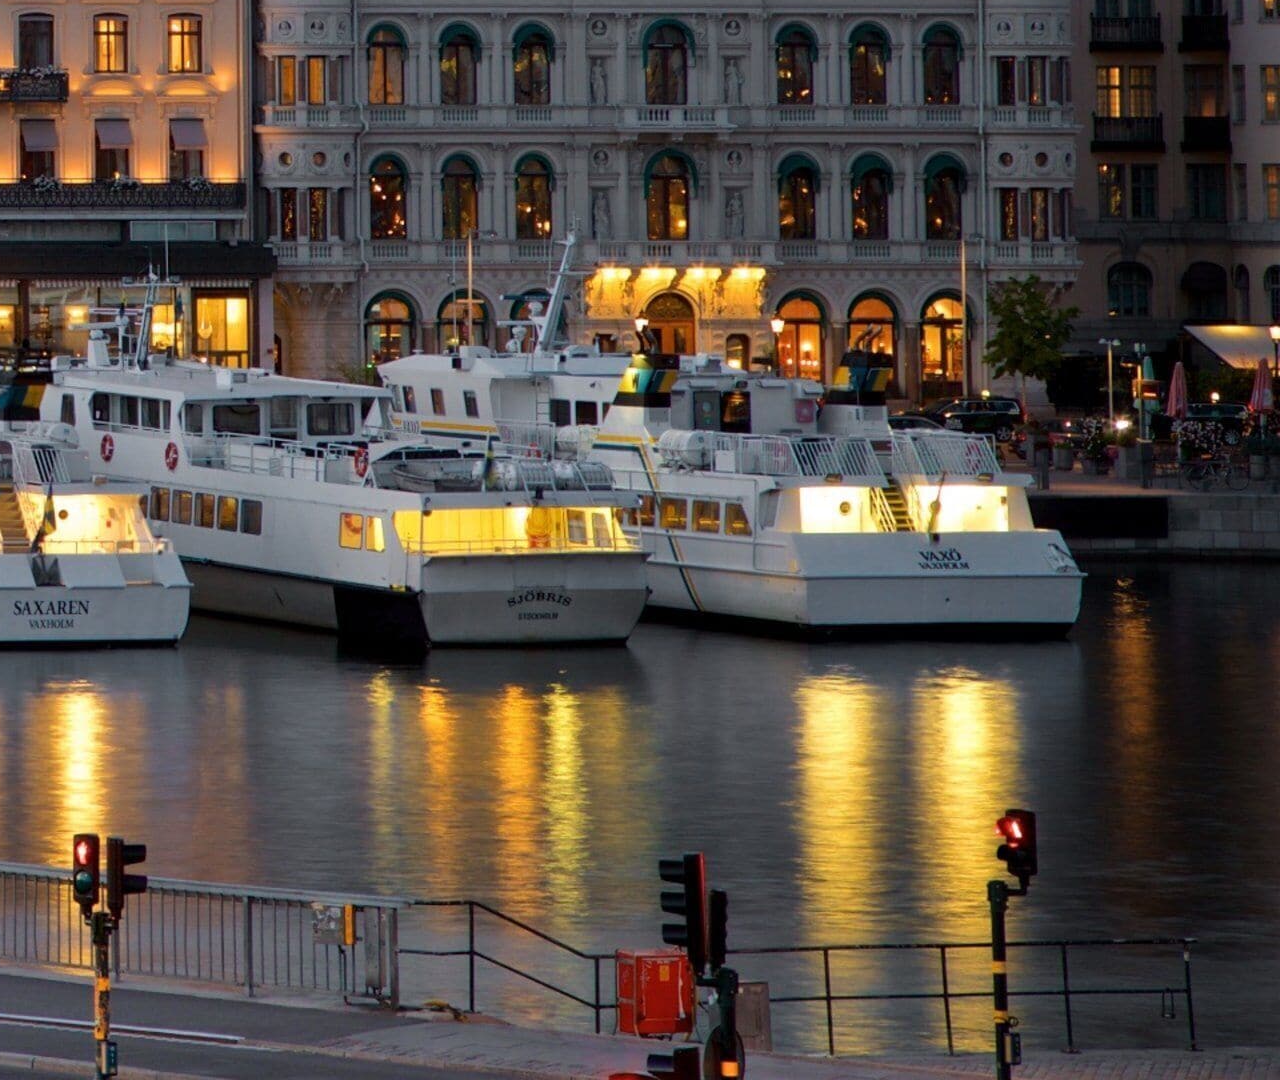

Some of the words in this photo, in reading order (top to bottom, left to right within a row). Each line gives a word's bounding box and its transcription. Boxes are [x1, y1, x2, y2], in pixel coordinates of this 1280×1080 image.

[918, 548, 962, 561] VAXÖ
[506, 590, 573, 608] SJÖBRIS
[13, 600, 90, 616] SAXAREN
[28, 619, 75, 629] VAXHOLM
